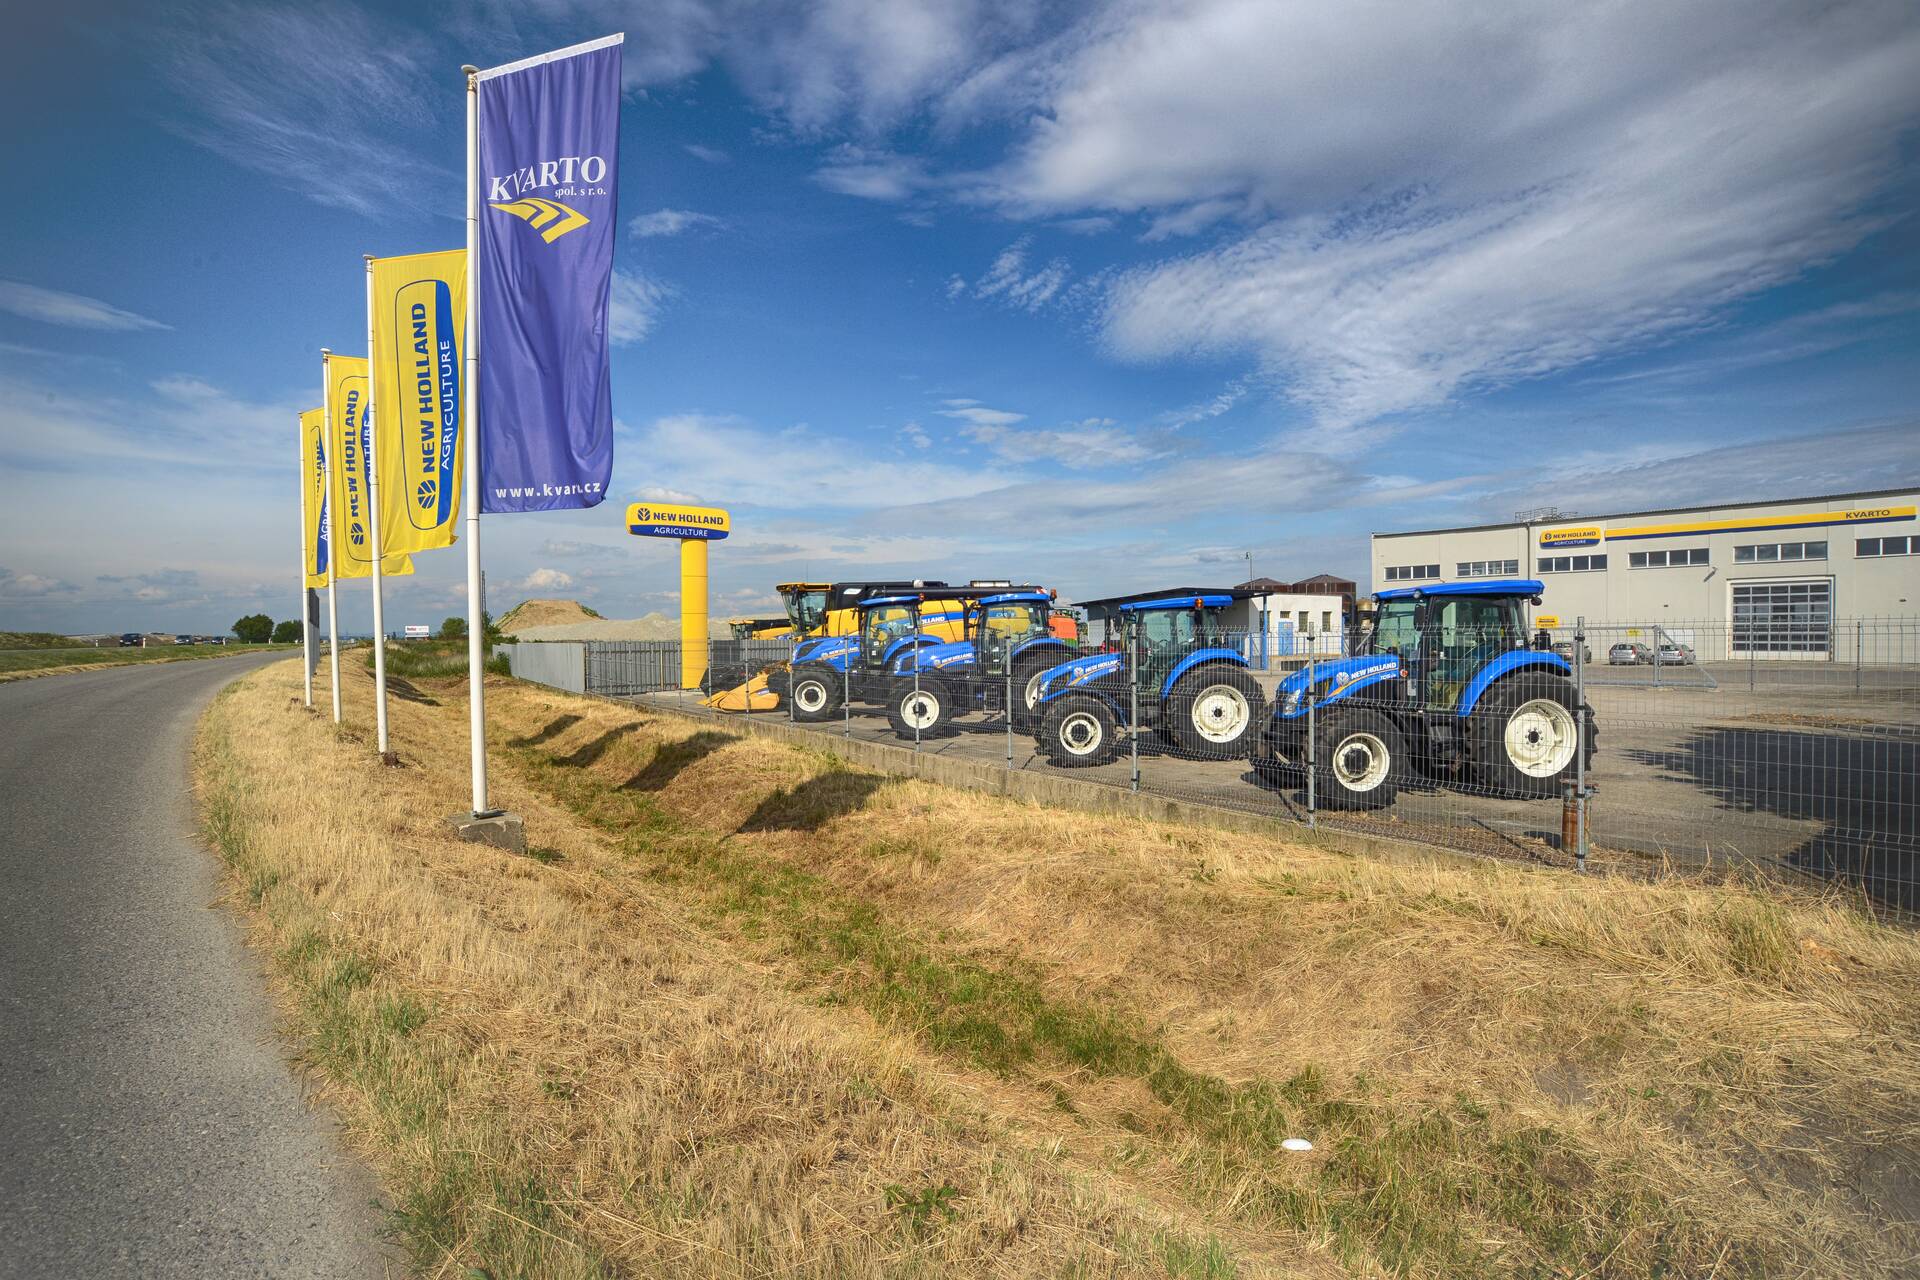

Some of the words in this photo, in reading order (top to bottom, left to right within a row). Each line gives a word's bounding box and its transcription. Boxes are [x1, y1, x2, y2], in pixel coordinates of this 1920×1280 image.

[487, 156, 606, 200] KVARTO
[555, 185, 577, 199] spol.
[580, 188, 586, 196] s
[588, 188, 596, 196] r.
[597, 187, 606, 196] o.
[411, 303, 433, 413] HOLLAND
[440, 340, 454, 470] AGRICULTURE
[345, 390, 360, 472] HOLLAND
[420, 420, 435, 473] NEW
[653, 512, 677, 522] NEW
[679, 514, 724, 525] HOLLAND
[1845, 509, 1890, 519] KVARTO
[653, 526, 708, 537] AGRICULTURE
[1351, 669, 1367, 680] NEW
[1368, 662, 1397, 673] HOLLAND
